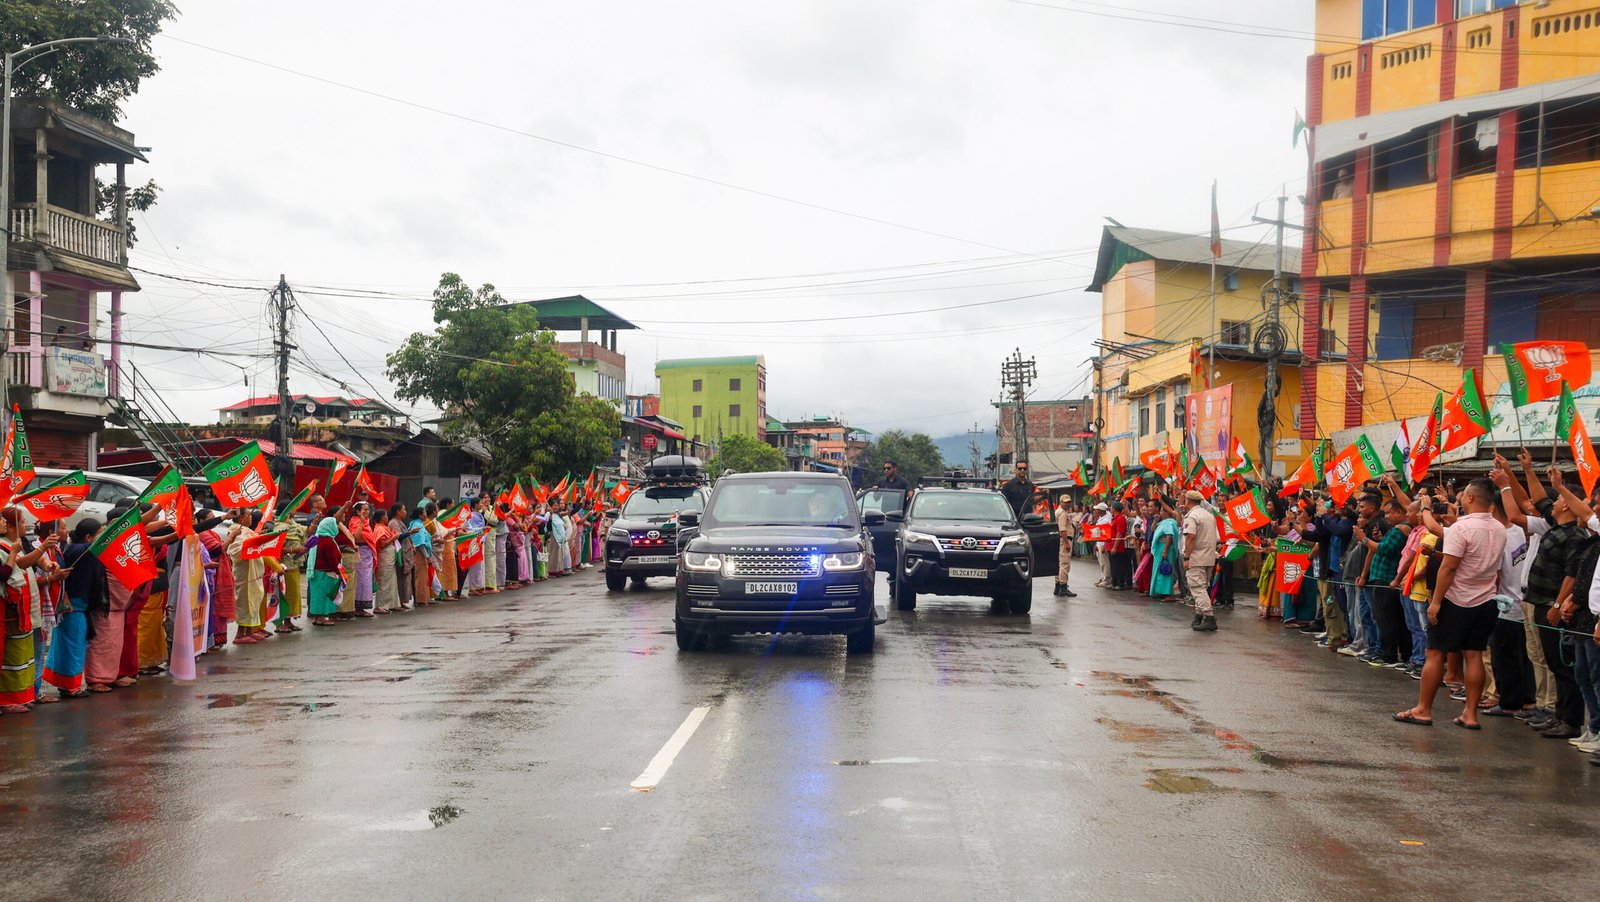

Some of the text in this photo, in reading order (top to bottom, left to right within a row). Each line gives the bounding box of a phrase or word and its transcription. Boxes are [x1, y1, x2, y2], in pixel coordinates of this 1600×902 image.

[15, 419, 32, 469] BJP
[217, 454, 249, 477] BJP
[462, 481, 480, 489] ATM
[750, 583, 797, 592] DL2CAX8102
